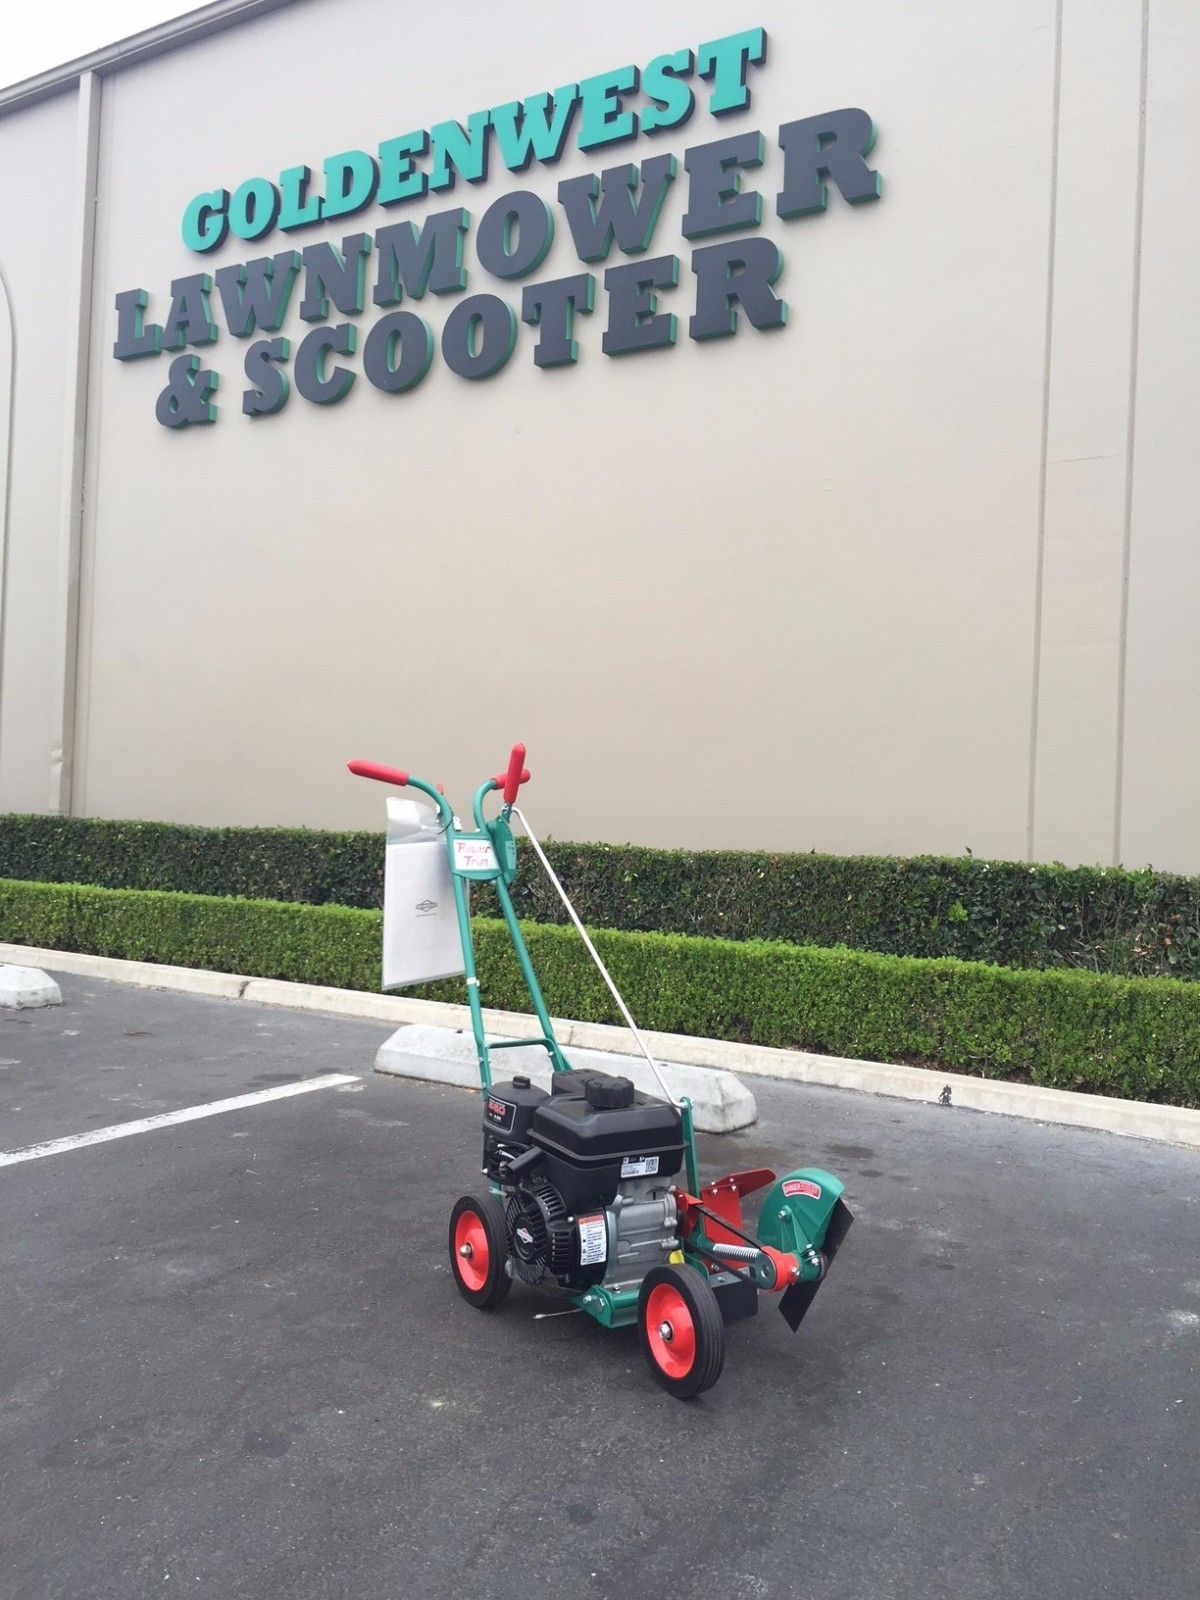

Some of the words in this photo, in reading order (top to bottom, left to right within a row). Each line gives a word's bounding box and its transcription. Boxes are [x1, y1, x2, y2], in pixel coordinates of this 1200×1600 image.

[113, 108, 880, 360] LAWNMOWER
[182, 27, 767, 253] GOLDENWEST
[156, 354, 218, 429] &
[243, 237, 788, 416] SCOOTER
[456, 842, 491, 853] Power
